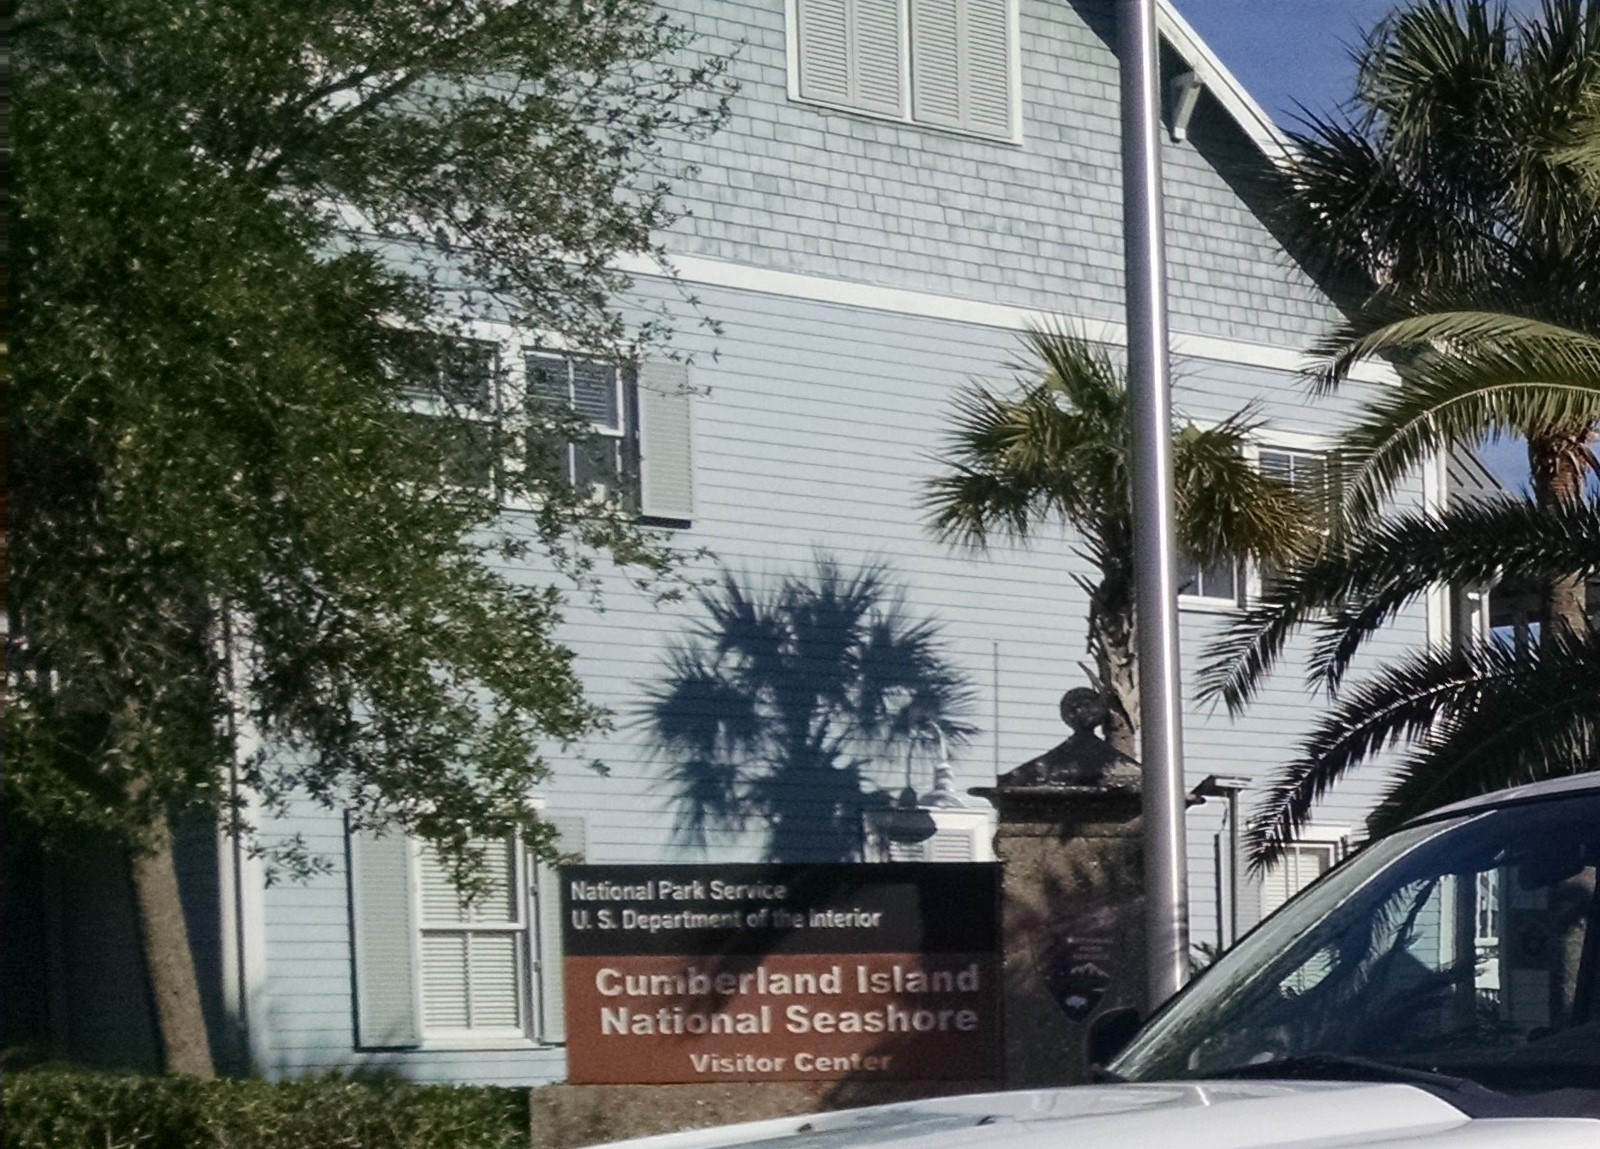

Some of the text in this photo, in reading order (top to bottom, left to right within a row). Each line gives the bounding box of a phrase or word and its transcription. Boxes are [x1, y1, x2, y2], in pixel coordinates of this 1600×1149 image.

[571, 880, 787, 901] National Park Service
[572, 907, 882, 933] U. S. Department of the Interior
[596, 963, 981, 997] Cumberland Island
[601, 1003, 978, 1036] National Seashore
[690, 1051, 893, 1073] Visitor Center
